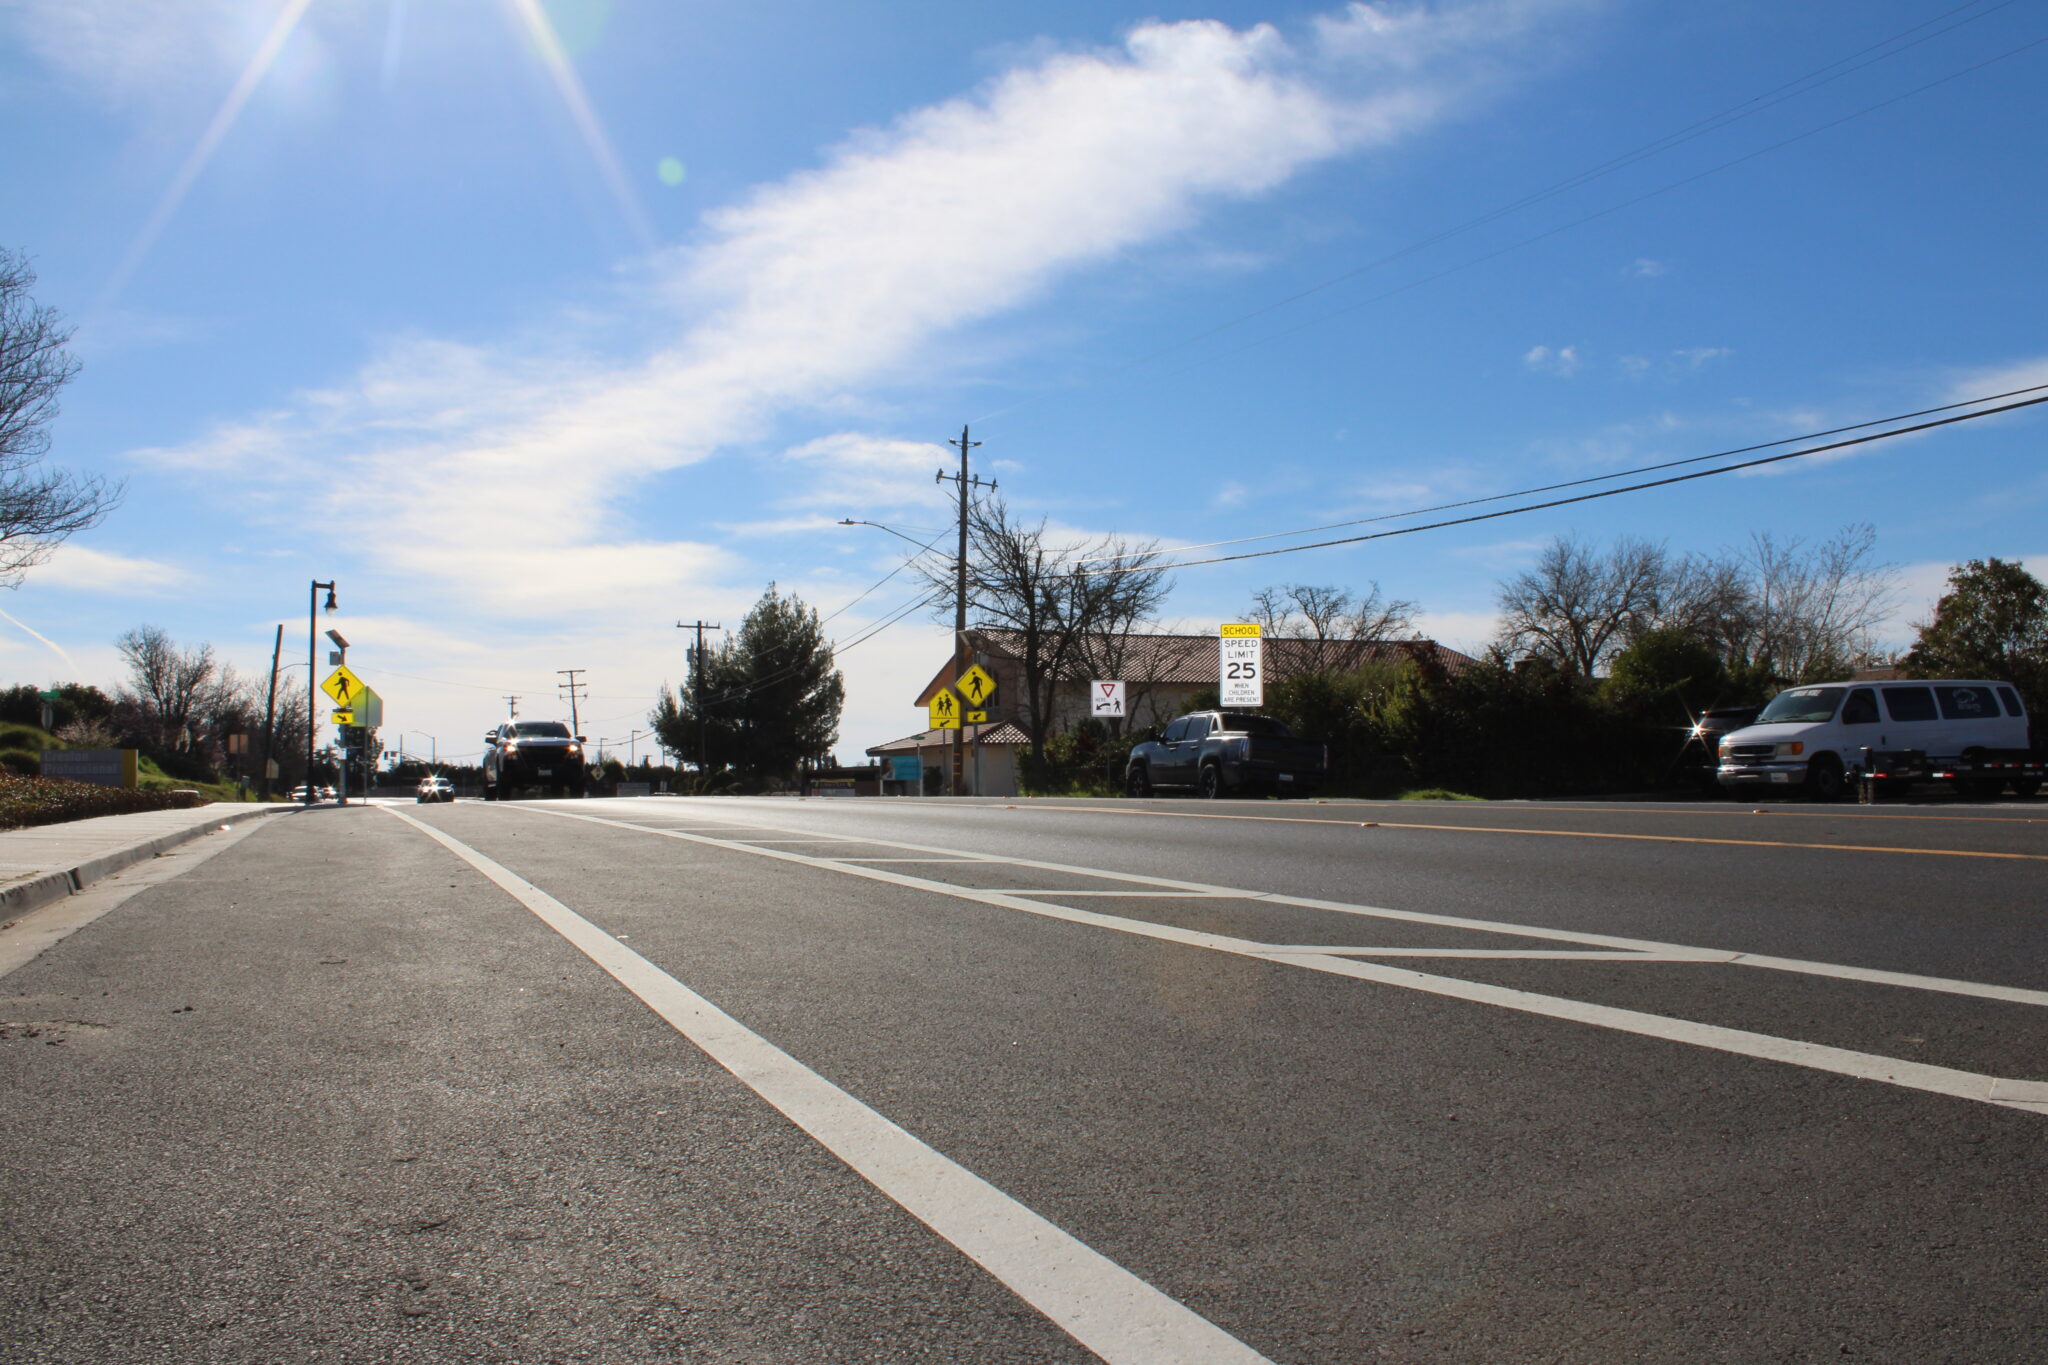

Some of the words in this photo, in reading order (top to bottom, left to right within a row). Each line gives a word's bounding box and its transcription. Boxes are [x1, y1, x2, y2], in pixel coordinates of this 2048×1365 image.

[1223, 627, 1259, 635] SCHOOL
[1224, 640, 1258, 648] SPEED
[1227, 662, 1256, 679] 25
